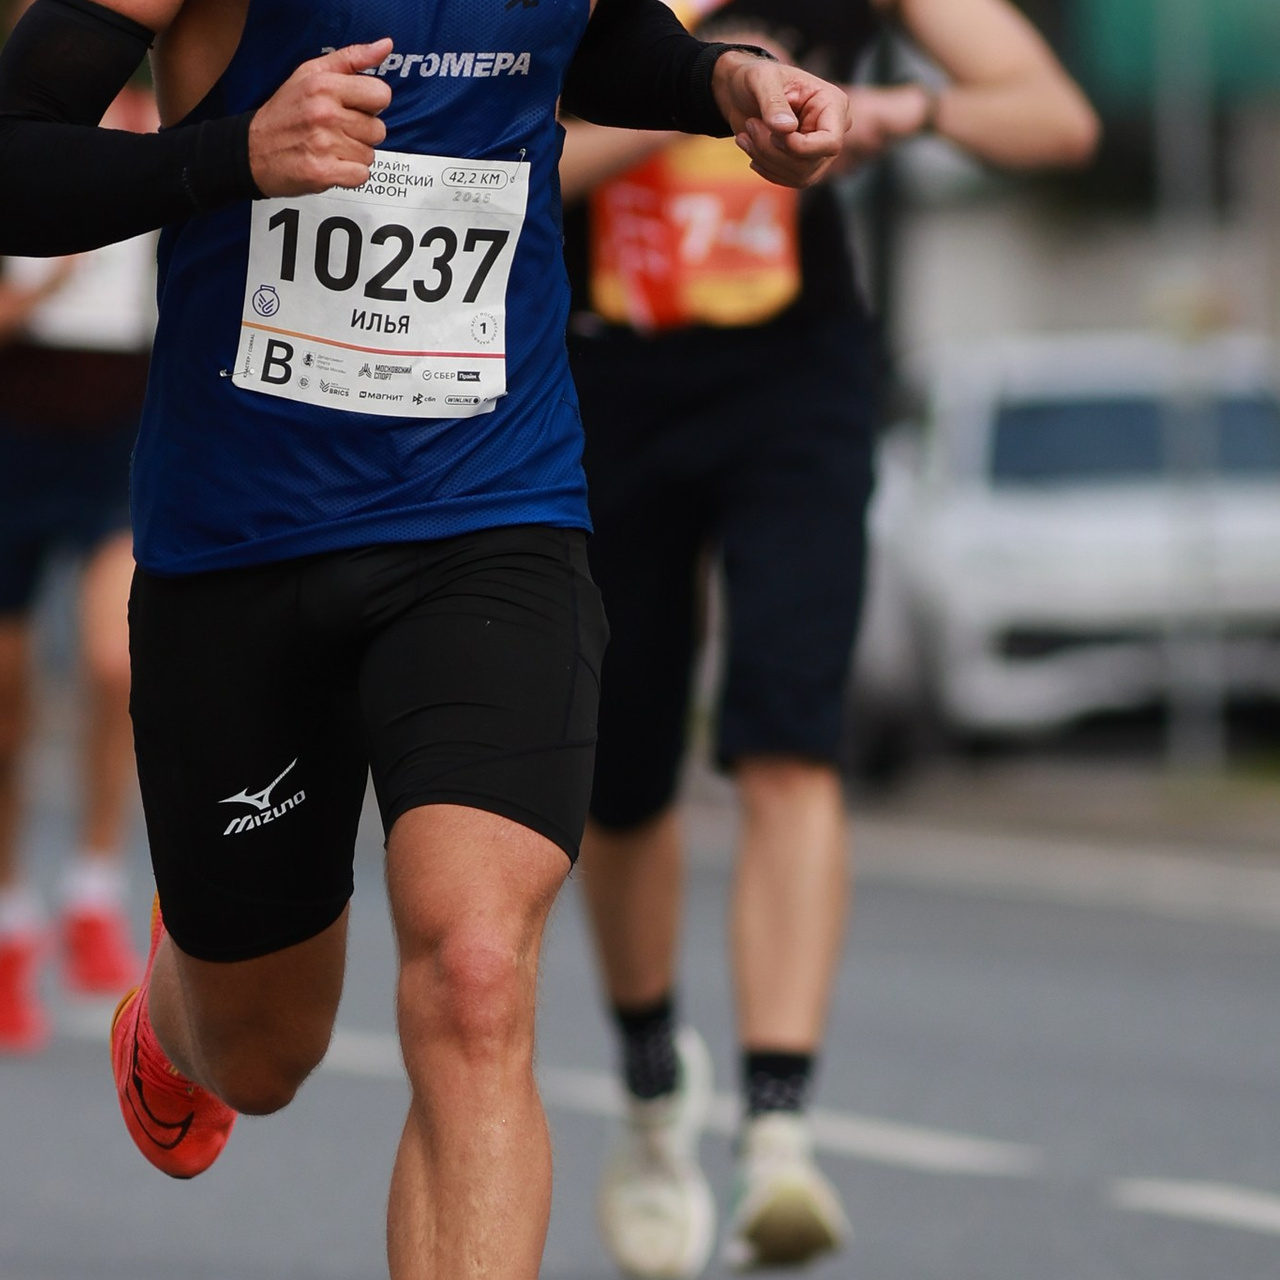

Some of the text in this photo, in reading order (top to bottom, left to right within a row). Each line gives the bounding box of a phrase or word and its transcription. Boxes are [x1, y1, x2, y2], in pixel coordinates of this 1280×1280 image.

[368, 170, 434, 187] КОВСКИЙ
[449, 170, 501, 186] 42,2 КМ
[268, 207, 510, 303] 10237
[350, 308, 411, 334] ИЛЬЯ
[479, 321, 487, 335] 1
[433, 371, 456, 380] СБЕР
[329, 388, 349, 397] BRICS
